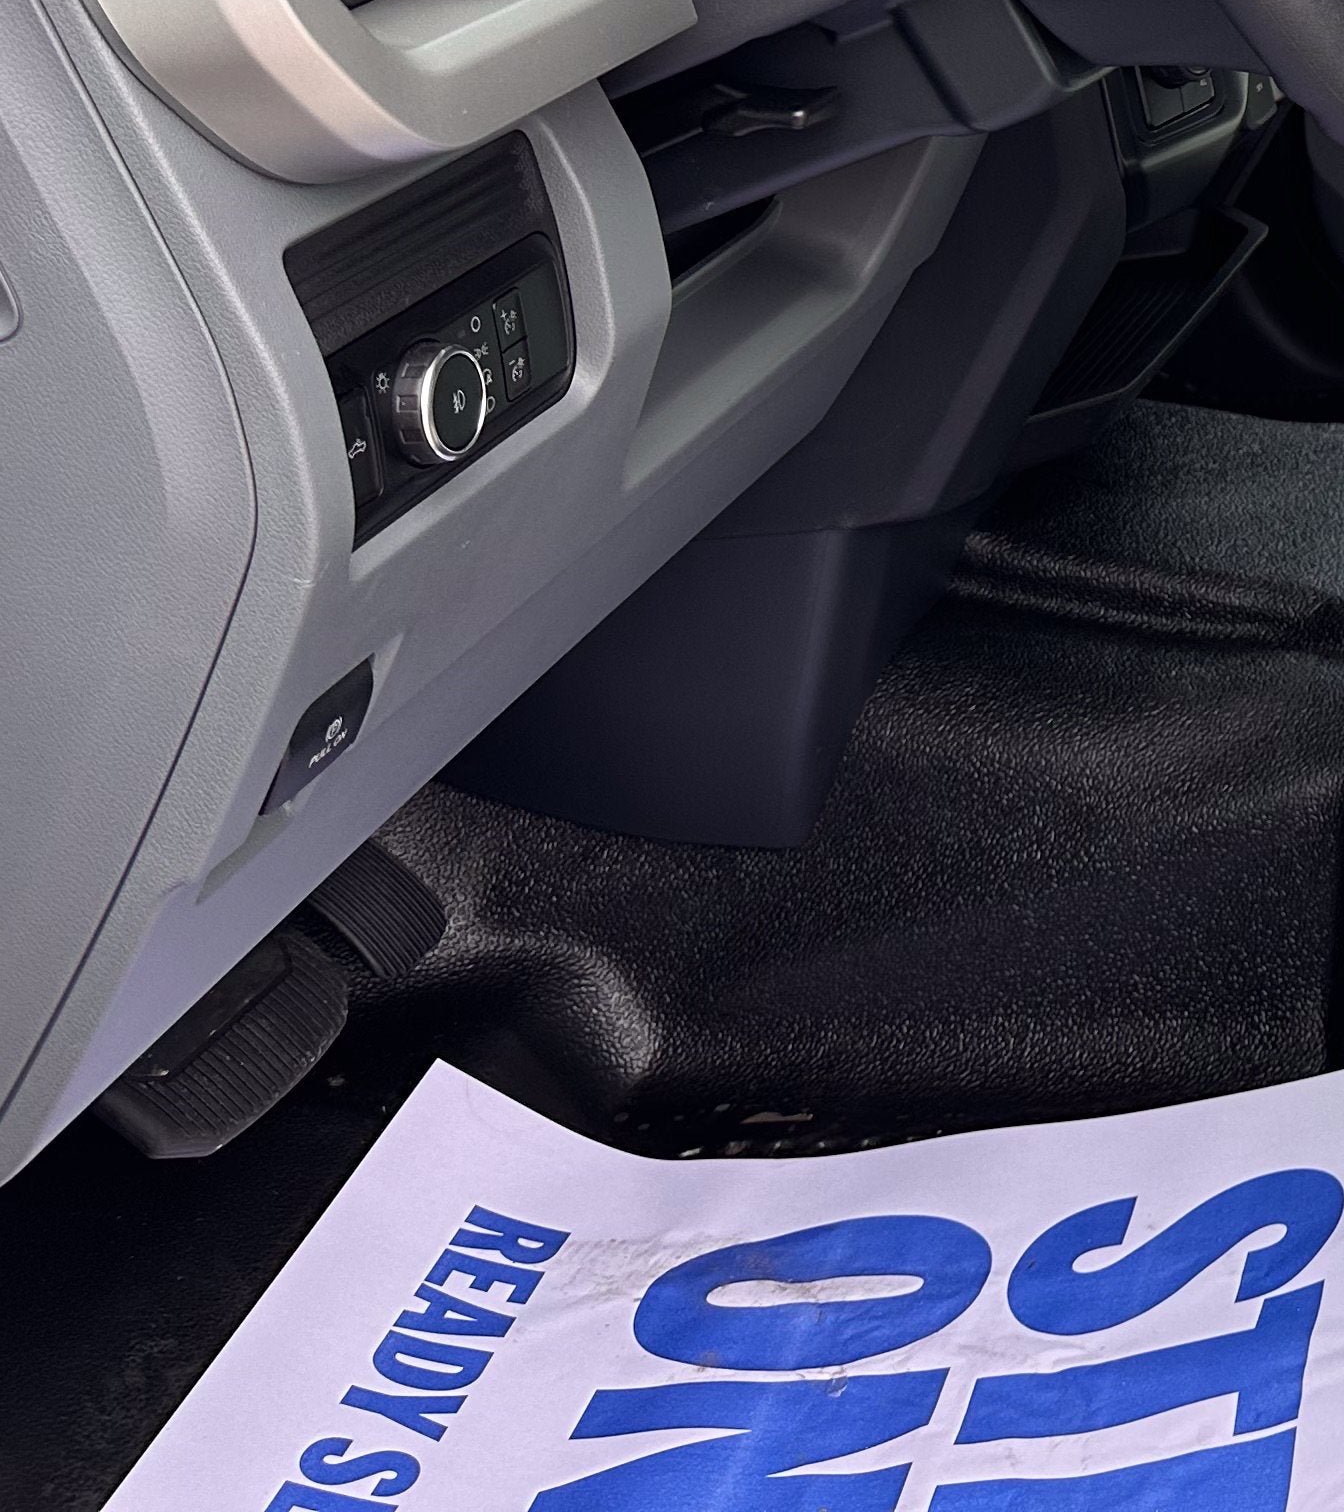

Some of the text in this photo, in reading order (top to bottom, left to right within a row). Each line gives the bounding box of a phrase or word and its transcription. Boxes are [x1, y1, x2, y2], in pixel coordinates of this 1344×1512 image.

[308, 728, 348, 768] PULL ON
[339, 1204, 572, 1442] READY
